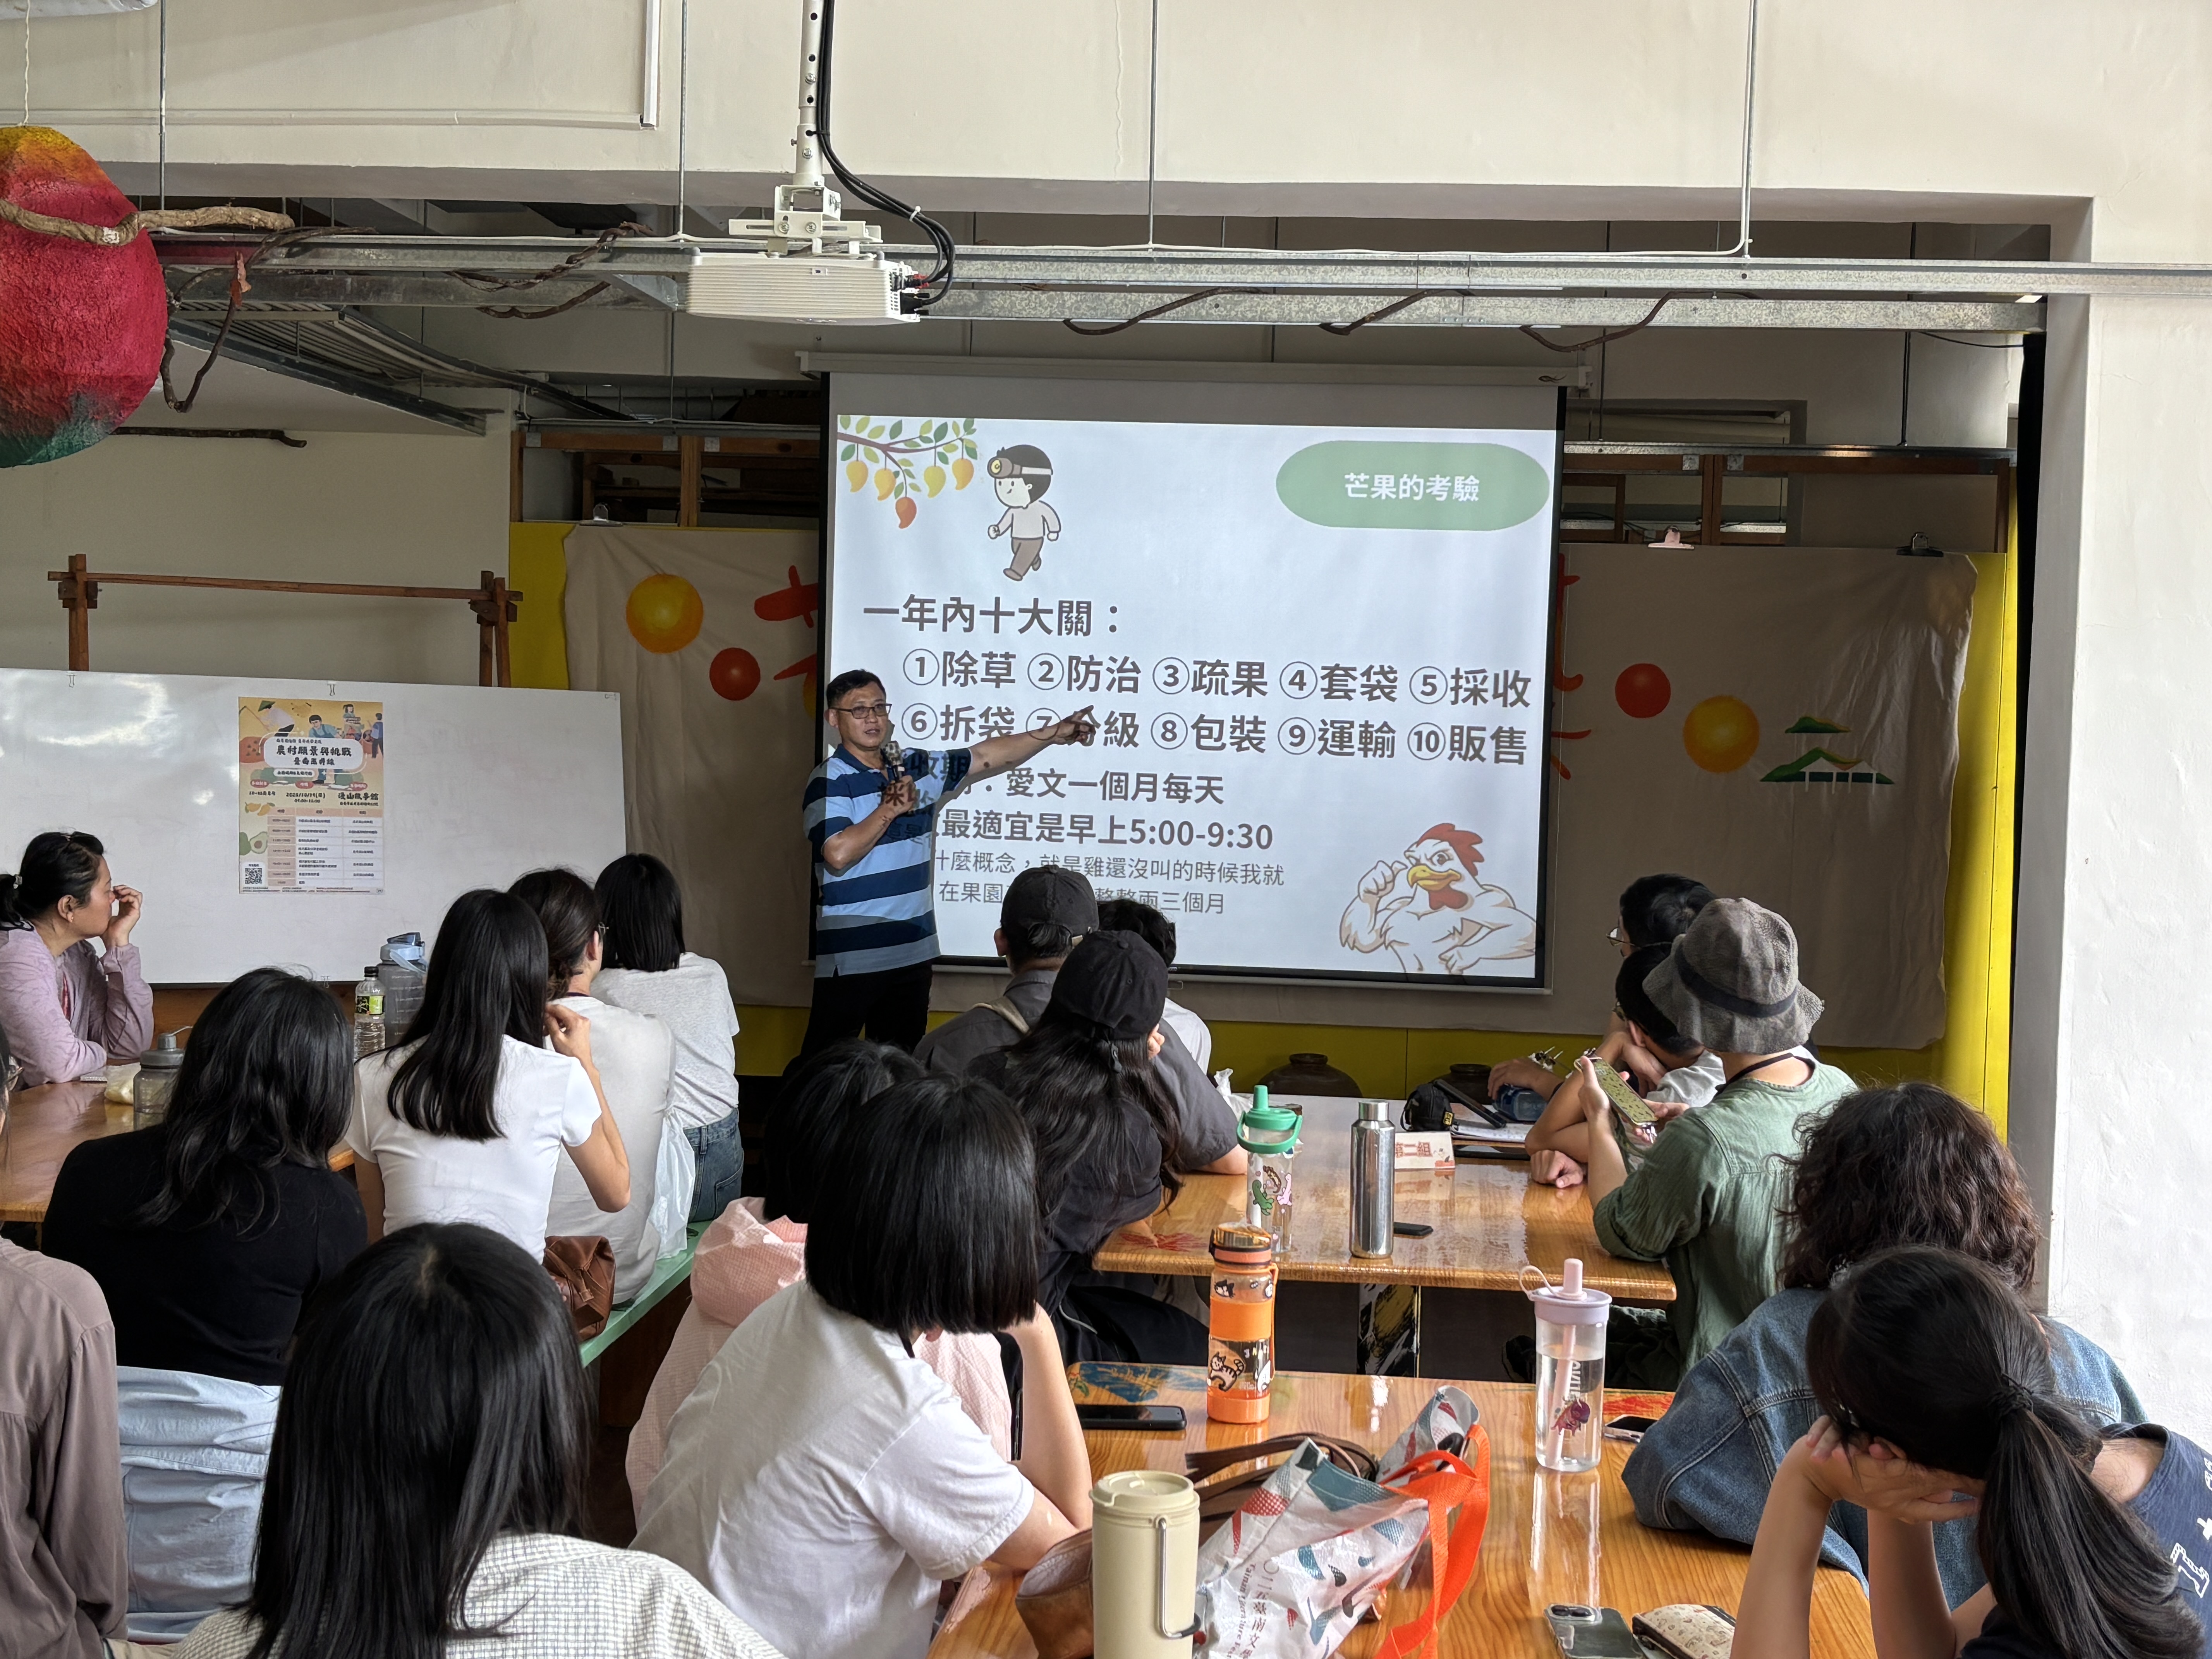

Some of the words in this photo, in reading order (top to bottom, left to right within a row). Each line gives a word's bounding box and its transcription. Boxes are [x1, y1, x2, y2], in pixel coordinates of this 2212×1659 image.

[1345, 472, 1480, 501] 芒果的考驗
[863, 593, 1118, 637] 一年內十大關：
[934, 808, 1273, 850] 最適宜是早上5:00-9:30
[939, 880, 1008, 903] 在果園
